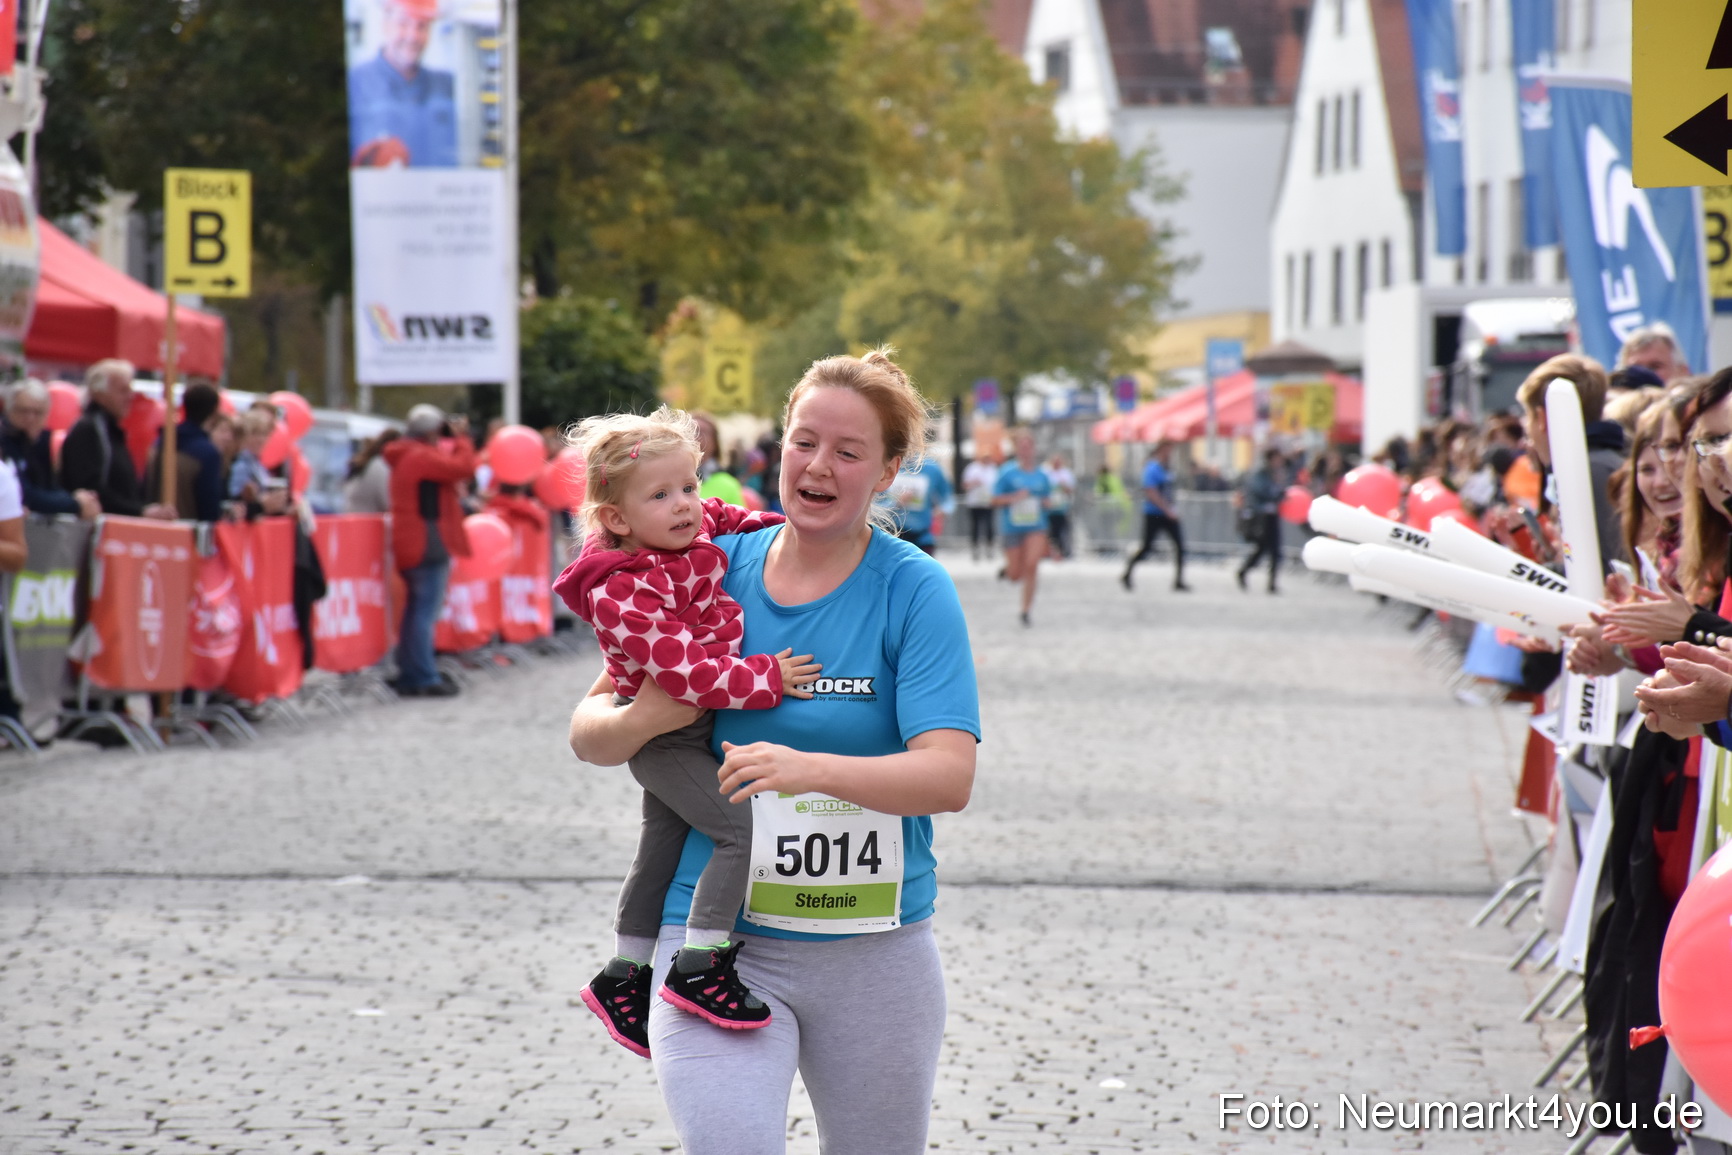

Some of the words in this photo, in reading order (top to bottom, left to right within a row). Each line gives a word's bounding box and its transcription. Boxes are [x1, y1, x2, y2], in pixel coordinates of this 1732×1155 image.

[176, 177, 238, 199] Block
[189, 210, 227, 265] B
[715, 361, 741, 396] C
[794, 677, 876, 695] BOCK
[811, 800, 863, 811] BOCK
[775, 830, 882, 878] 5014
[758, 869, 765, 877] S
[795, 892, 857, 909] Stefanie
